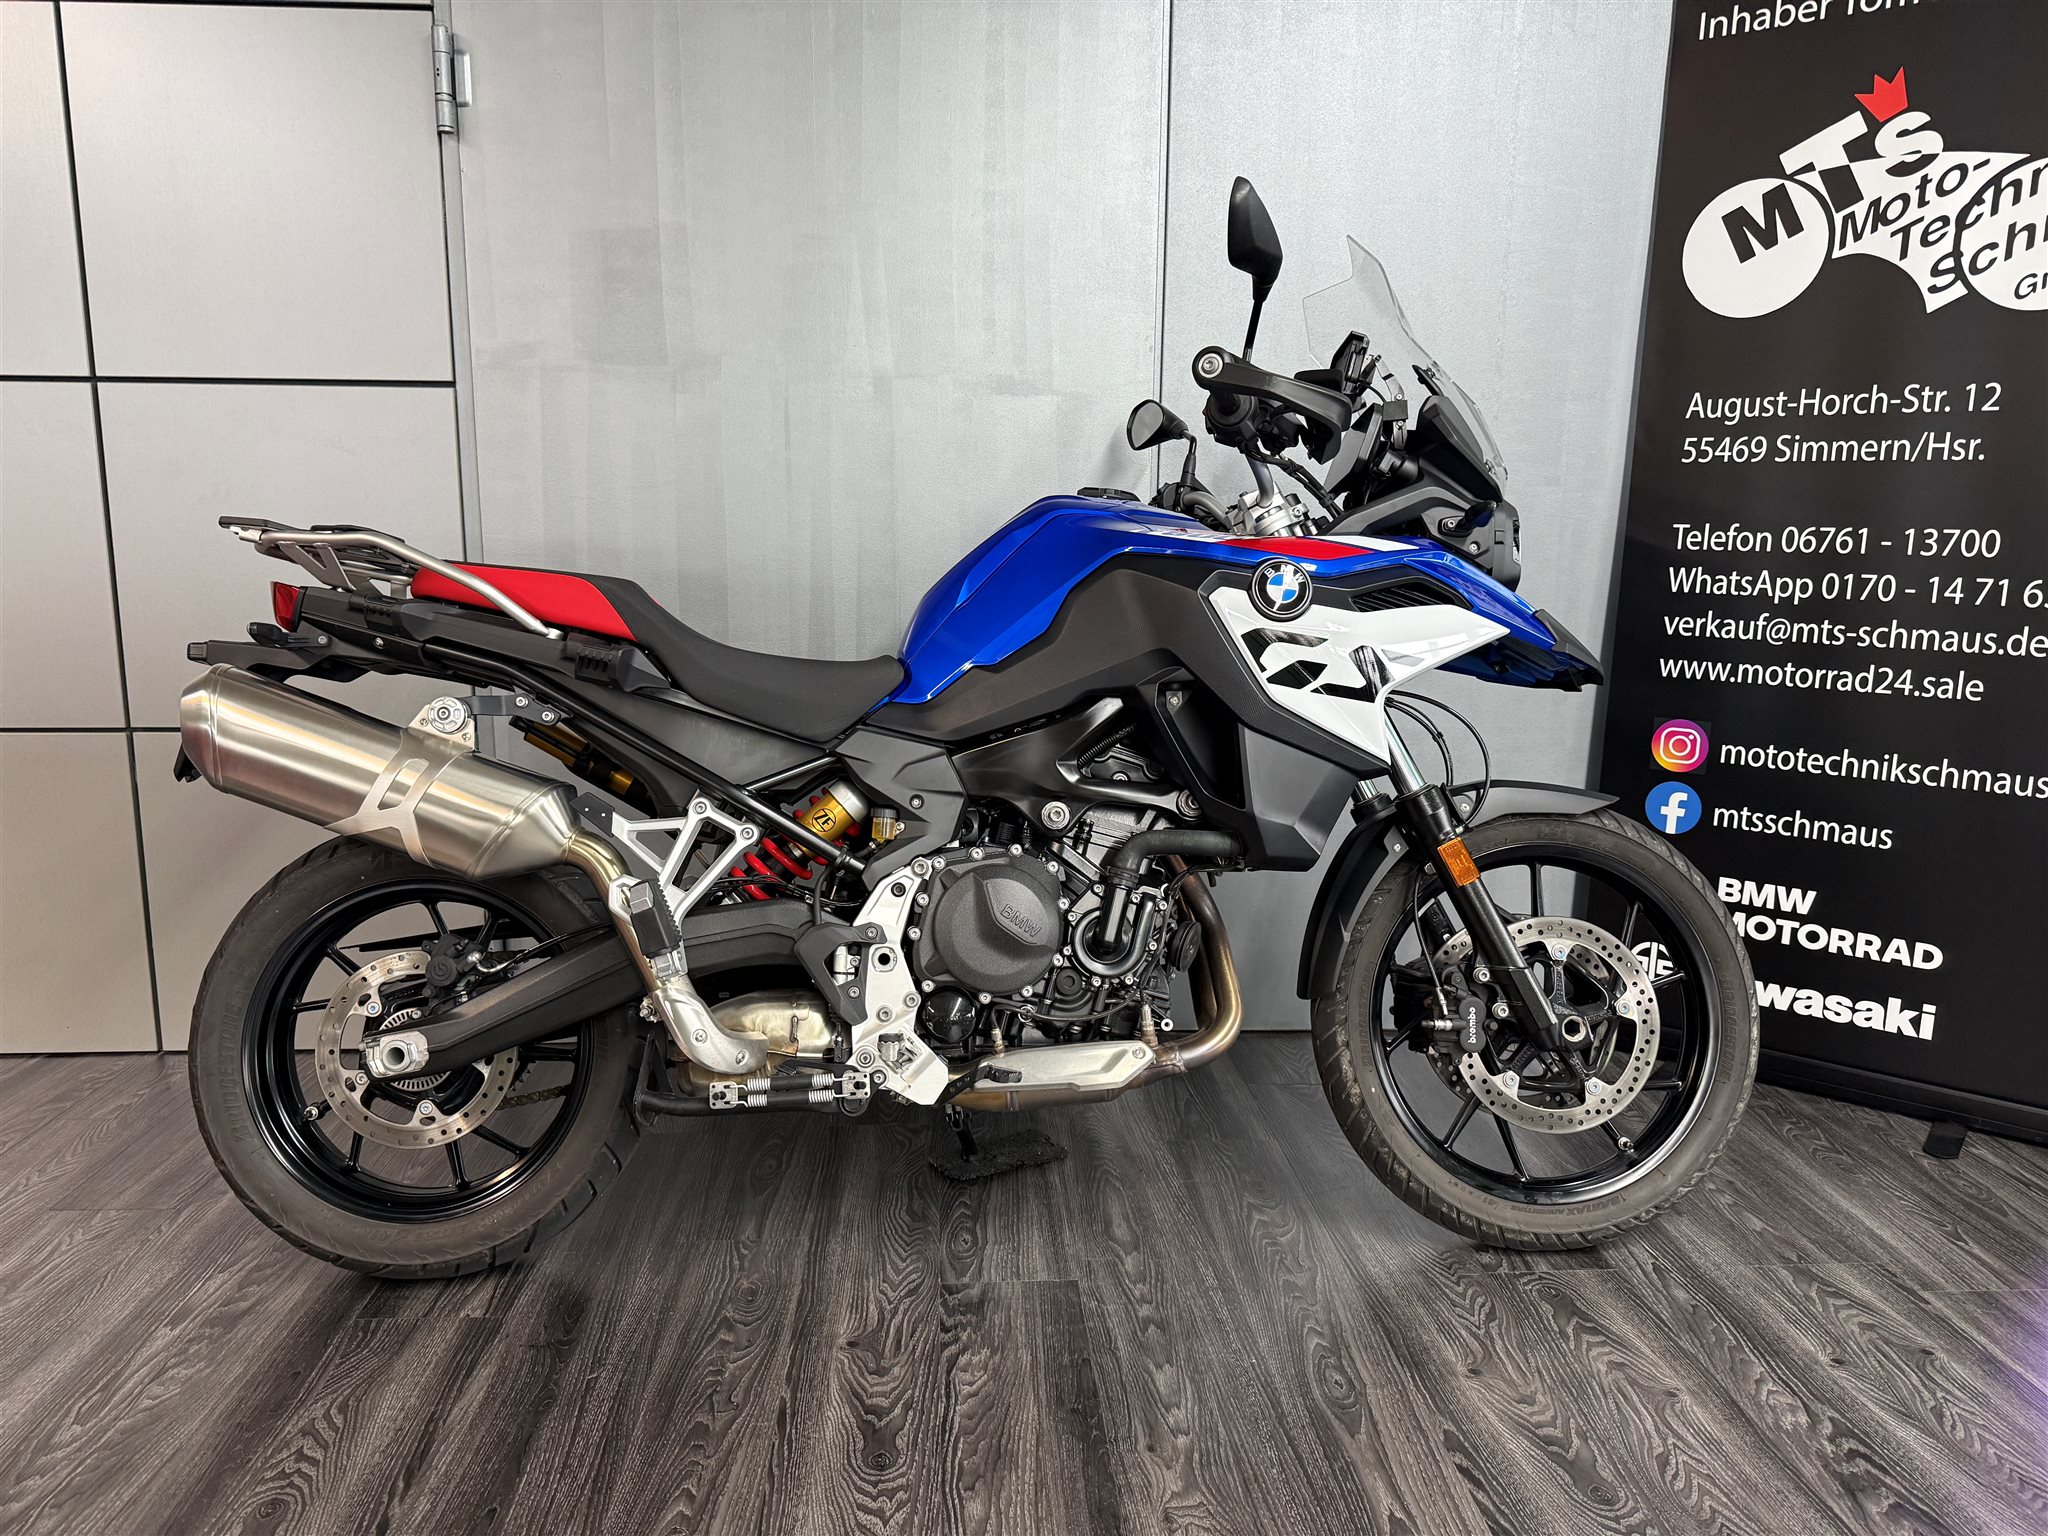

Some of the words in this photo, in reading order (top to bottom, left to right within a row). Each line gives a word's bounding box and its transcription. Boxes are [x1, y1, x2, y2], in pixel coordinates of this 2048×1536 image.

[1698, 0, 1833, 41] Inhaber
[1721, 110, 1945, 264] MTS
[1838, 157, 1991, 251] Moto-
[1927, 213, 2048, 294] Sch
[2013, 271, 2048, 300] G
[1685, 383, 1951, 426] August-Horch-Str.
[1965, 382, 2001, 412] 12
[1681, 436, 1768, 463] 55469
[1774, 431, 1985, 463] Simmern/Hsr.
[1672, 522, 1773, 552] Telefon
[1781, 526, 1869, 555] 06761
[1904, 528, 2001, 558] 13700
[1668, 566, 1814, 606] WhatsApp
[1821, 572, 1897, 602] 0170
[1928, 576, 1965, 605] 14
[1974, 577, 2010, 607] 71
[2023, 579, 2048, 609] 6
[1663, 610, 2048, 658] verkauf@mts-schmaus.de
[1659, 658, 1984, 702] www.motorrad24.sale
[1720, 744, 2048, 799] mototechnikschmaus
[1712, 806, 1893, 850] mtsschmaus
[1717, 876, 1817, 915] BMW
[1000, 903, 1042, 937] BMW
[1467, 1006, 1476, 1044] brembo
[1754, 980, 1937, 1041] wasaki
